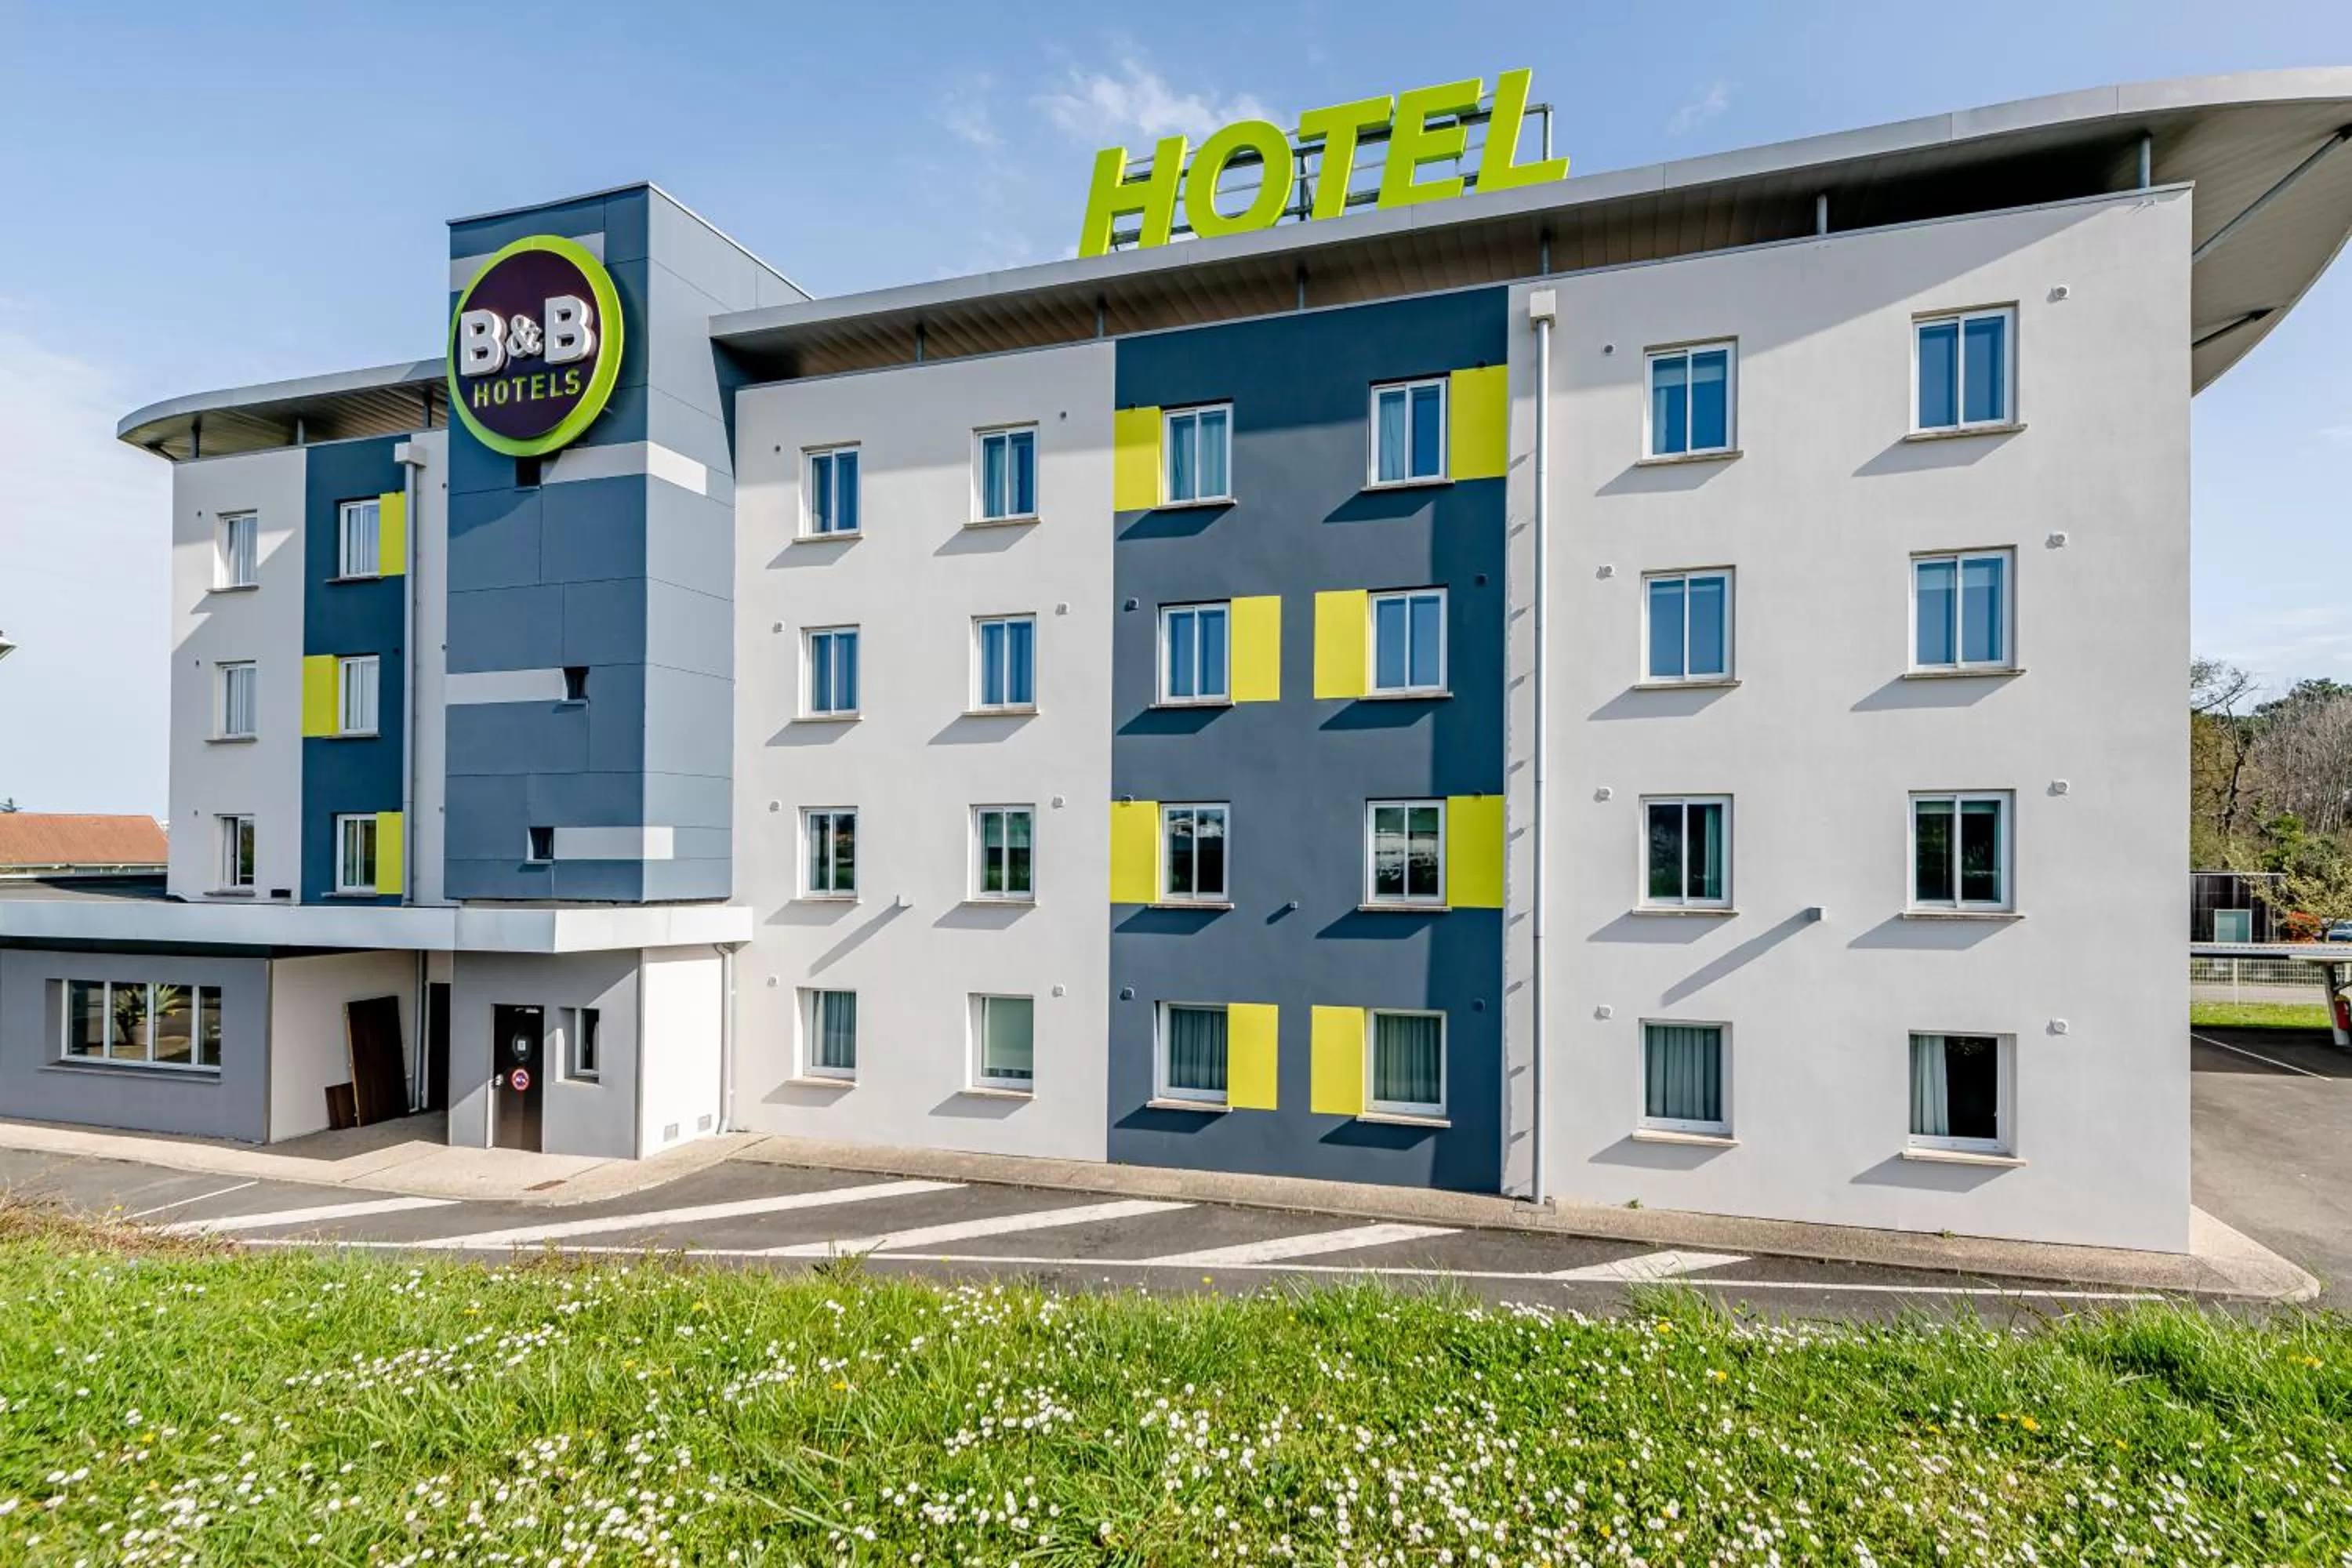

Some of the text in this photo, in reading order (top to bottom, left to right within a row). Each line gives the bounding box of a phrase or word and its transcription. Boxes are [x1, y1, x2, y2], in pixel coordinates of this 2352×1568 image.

[1079, 67, 1570, 259] HOTEL
[460, 295, 597, 376] B&B
[474, 368, 582, 408] HOTELS
